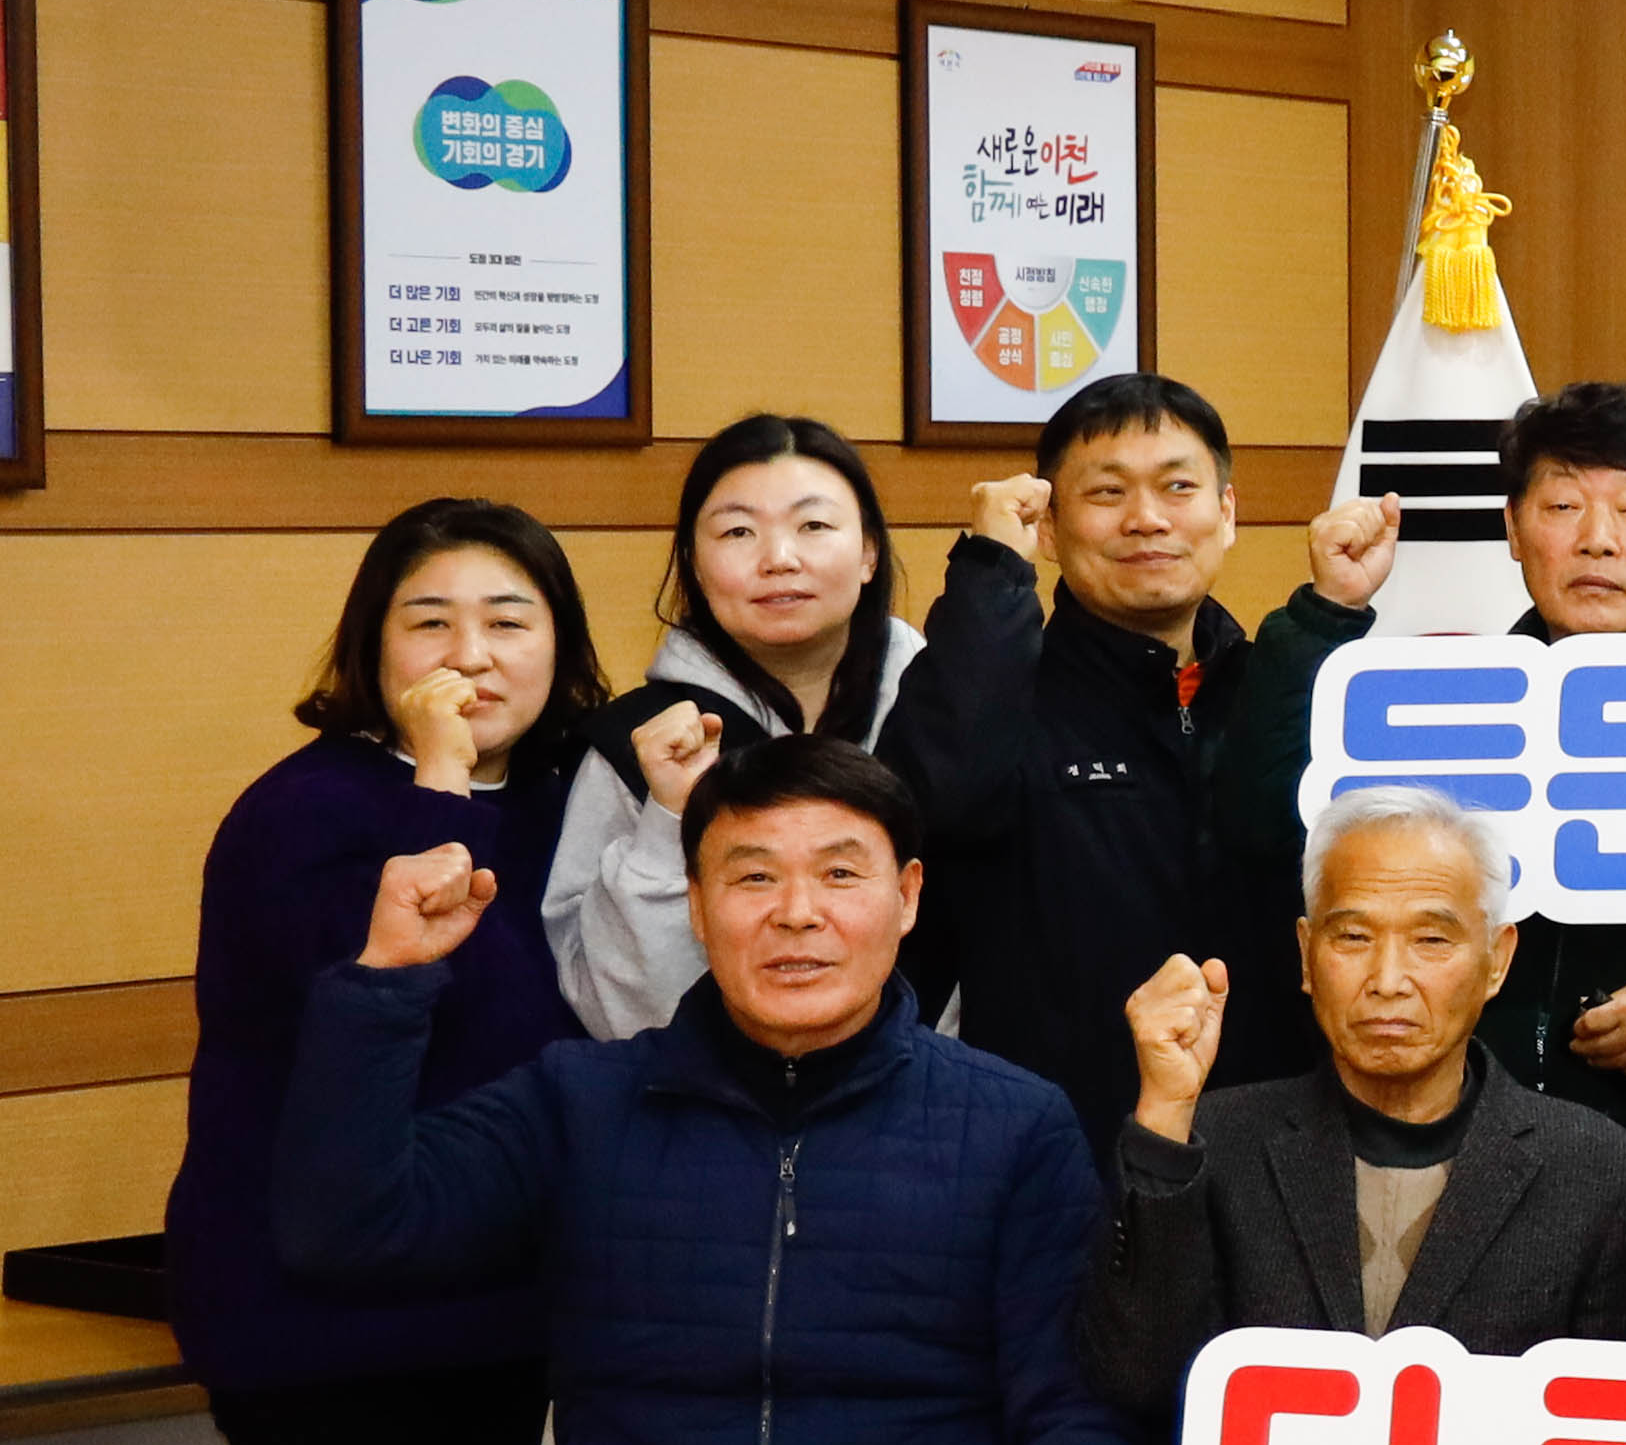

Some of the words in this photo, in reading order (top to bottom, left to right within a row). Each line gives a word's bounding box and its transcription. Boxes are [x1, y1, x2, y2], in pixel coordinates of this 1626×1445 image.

[441, 110, 500, 138] 변화의
[505, 115, 545, 141] 중심
[442, 139, 501, 166] 기회의
[505, 143, 545, 169] 경기
[977, 125, 1040, 176] 새로운
[1041, 134, 1098, 185] 이천
[963, 164, 1021, 223] 함께
[1055, 192, 1105, 225] 미래
[389, 285, 402, 300] 더
[406, 285, 431, 301] 많은
[436, 286, 461, 302] 기회
[390, 317, 402, 332] 더
[407, 317, 432, 333] 고른
[436, 318, 461, 334] 기회
[390, 349, 403, 364] 더
[407, 349, 432, 365] 나은
[436, 350, 462, 366] 기회
